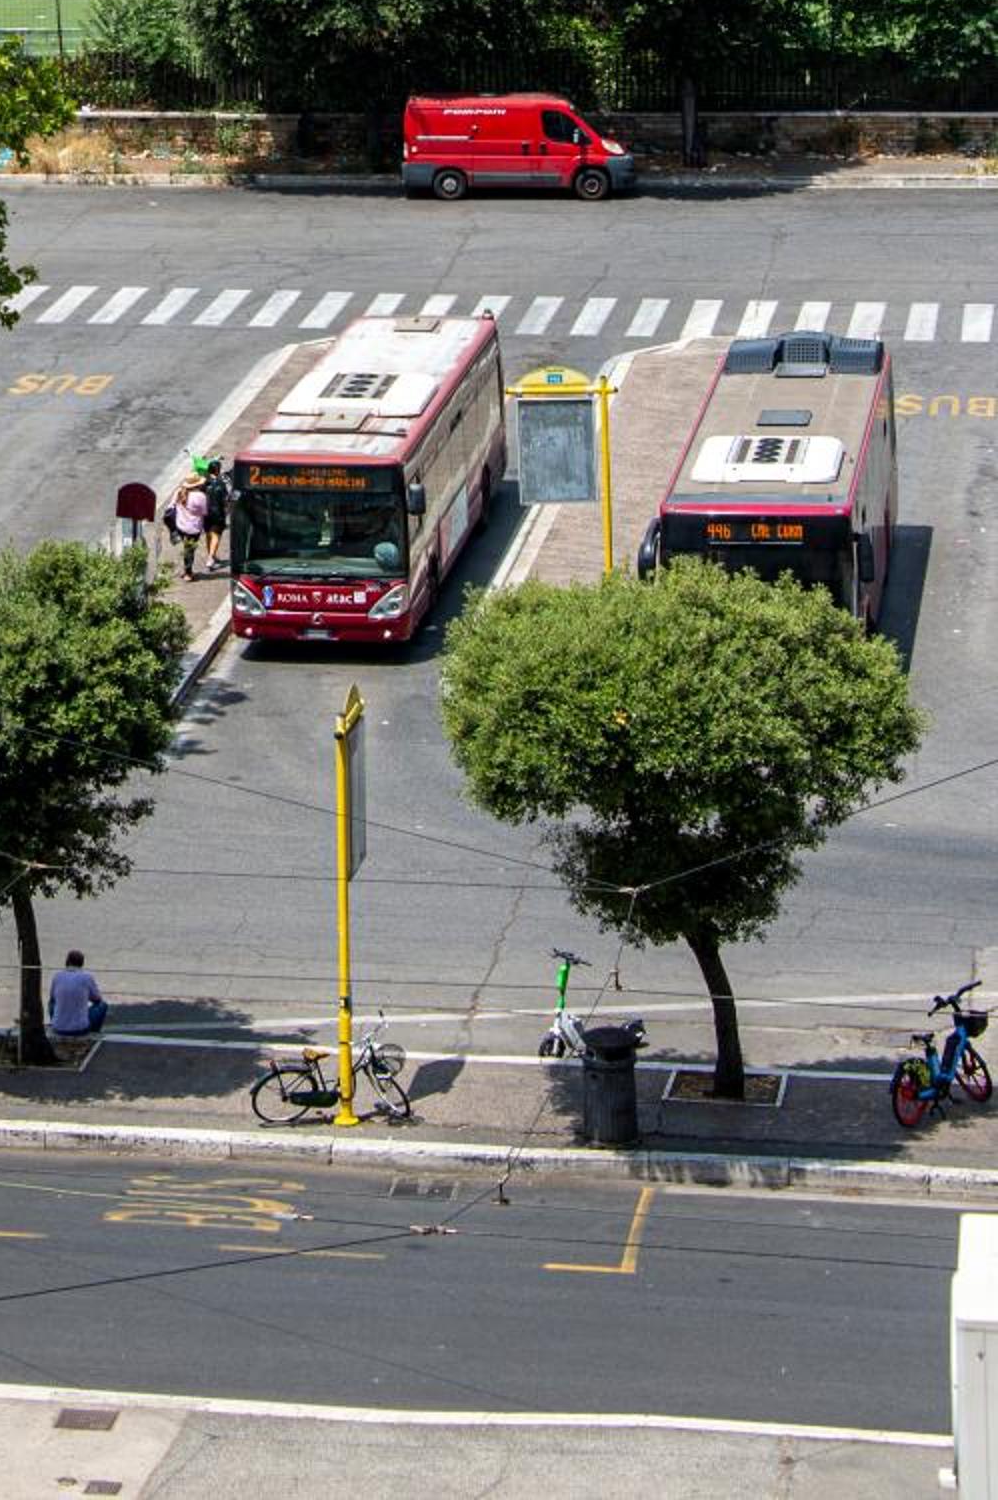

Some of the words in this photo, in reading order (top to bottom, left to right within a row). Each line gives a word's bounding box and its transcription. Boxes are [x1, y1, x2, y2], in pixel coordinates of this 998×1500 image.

[6, 372, 114, 396] BUS
[892, 394, 996, 418] BUS
[277, 592, 309, 604] ROMA
[326, 593, 353, 605] atac
[103, 1173, 307, 1233] BUS
